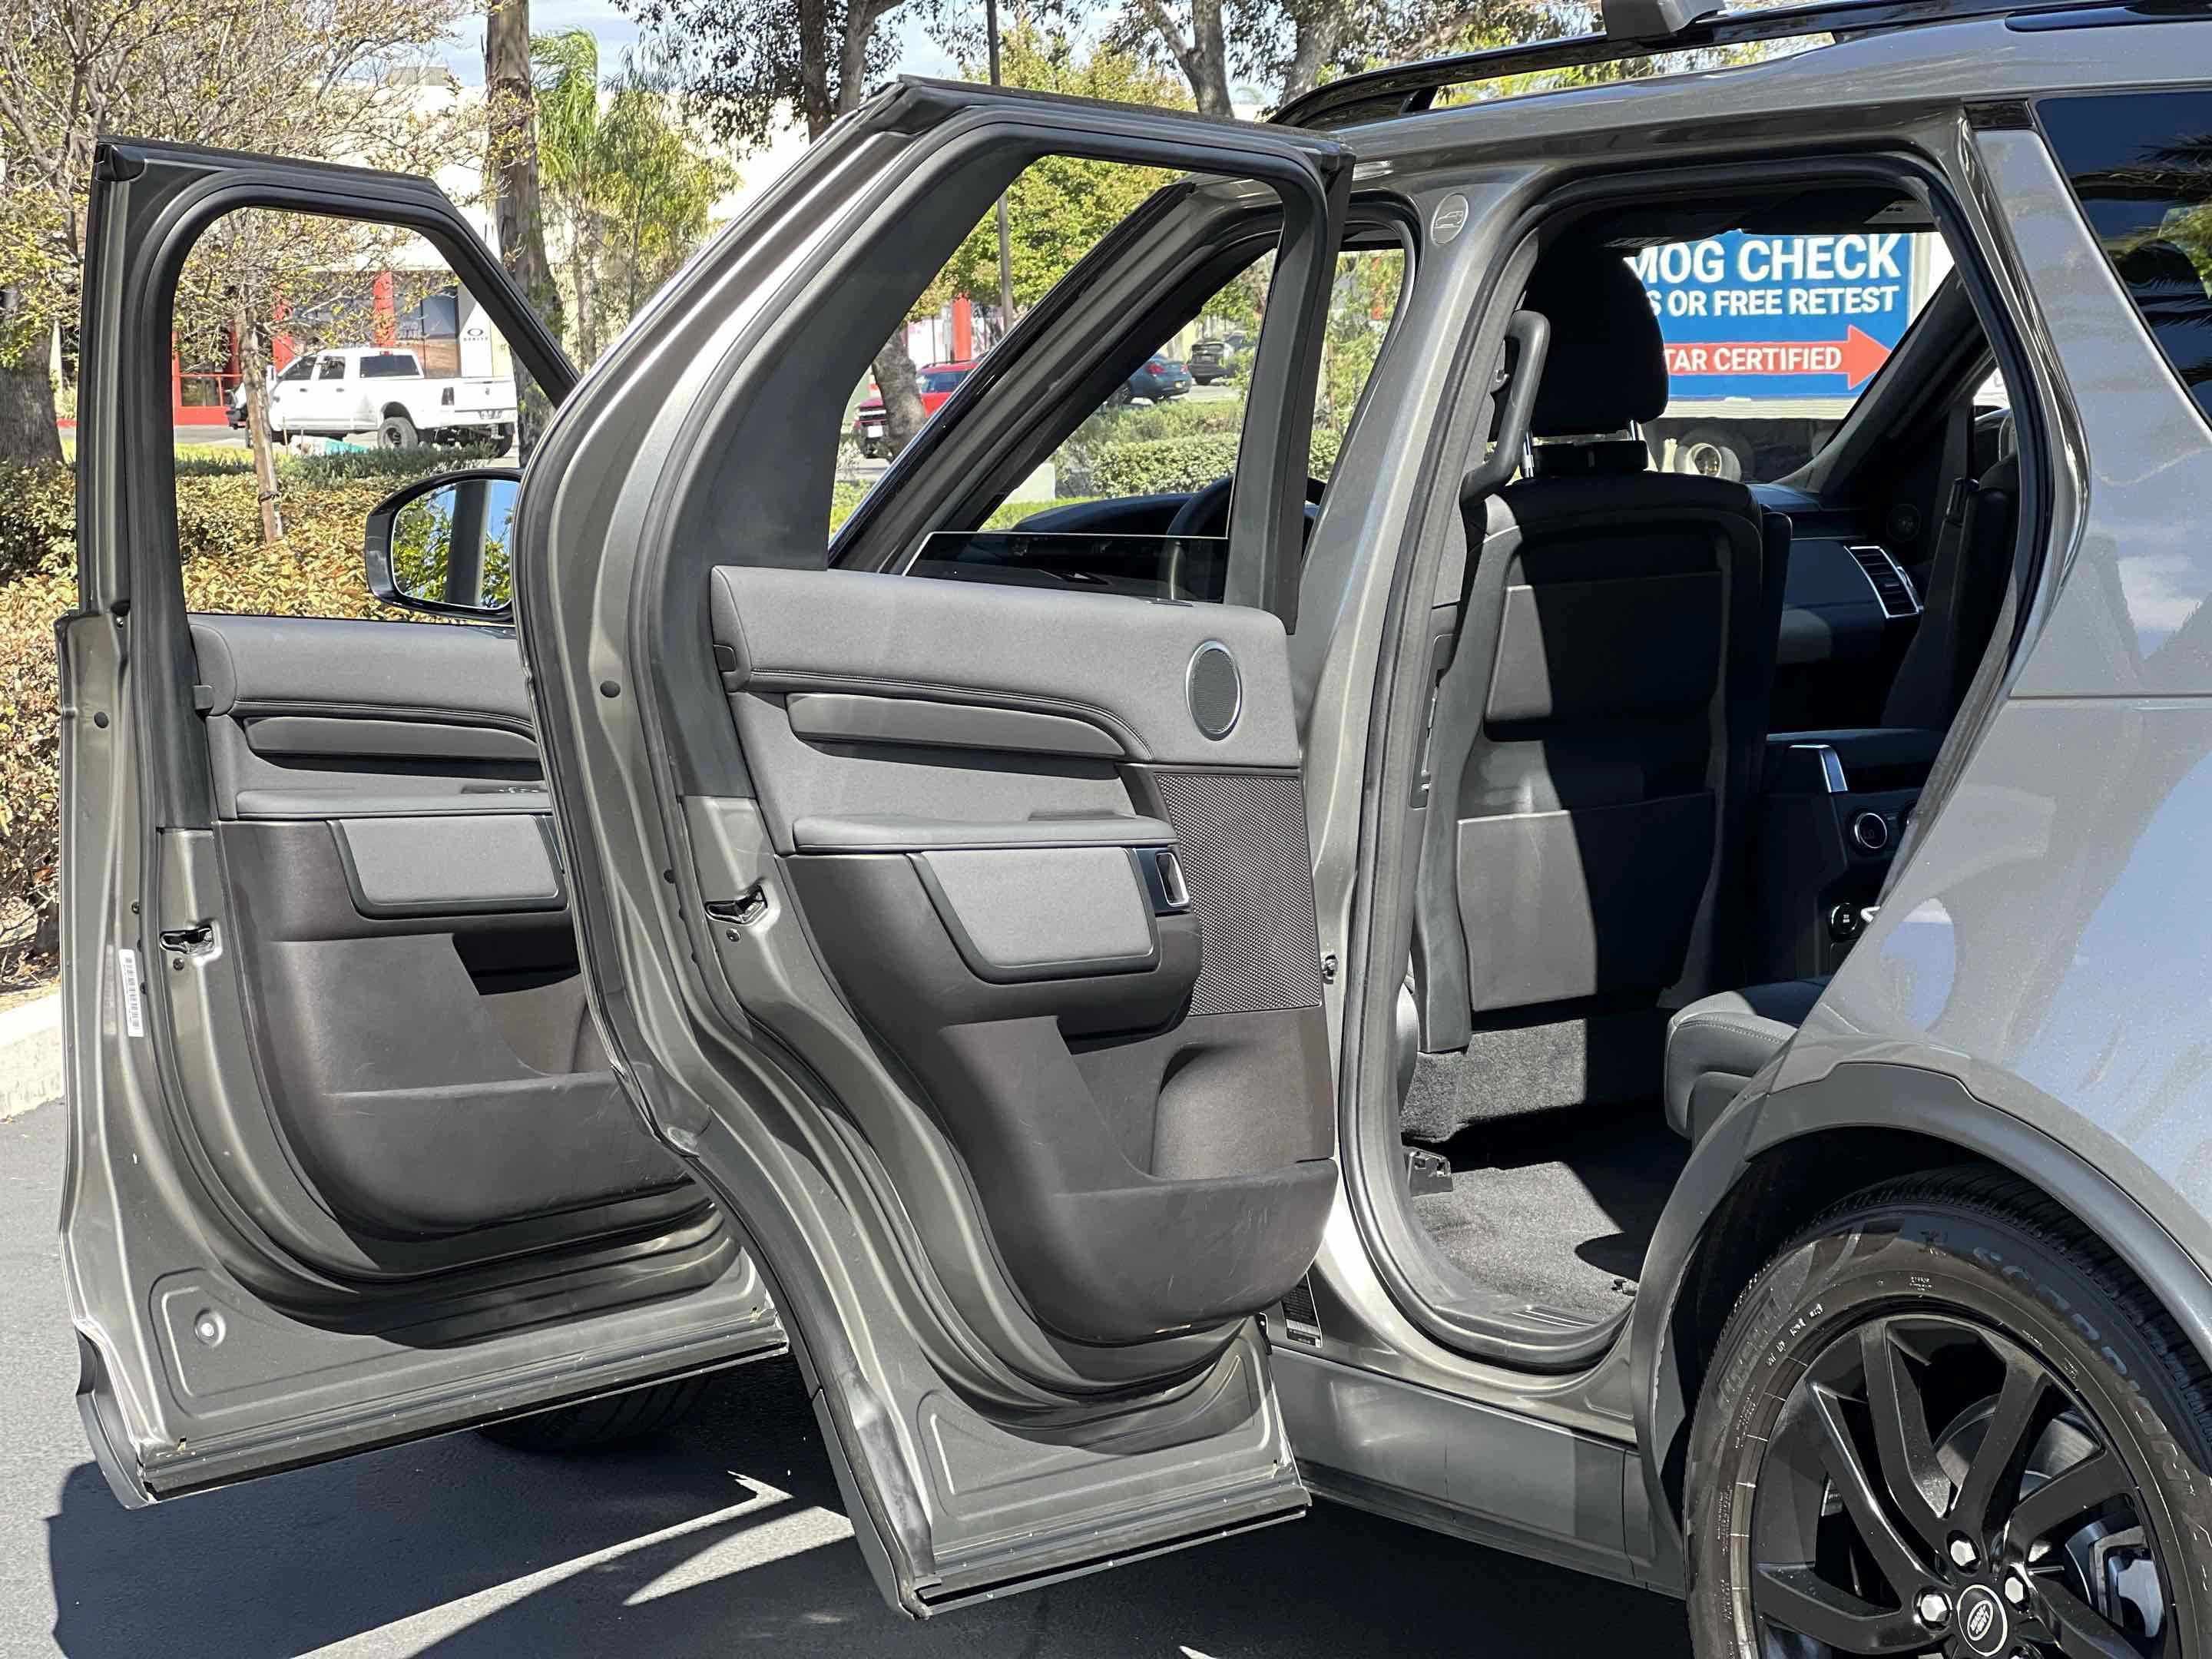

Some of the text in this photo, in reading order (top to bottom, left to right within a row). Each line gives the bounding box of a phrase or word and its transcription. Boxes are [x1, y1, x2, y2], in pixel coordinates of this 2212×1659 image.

[1623, 233, 1902, 283] MOG CHECK
[1646, 286, 1900, 316] S OR FREE RETEST
[1664, 347, 1843, 372] TAR CERTIFIED
